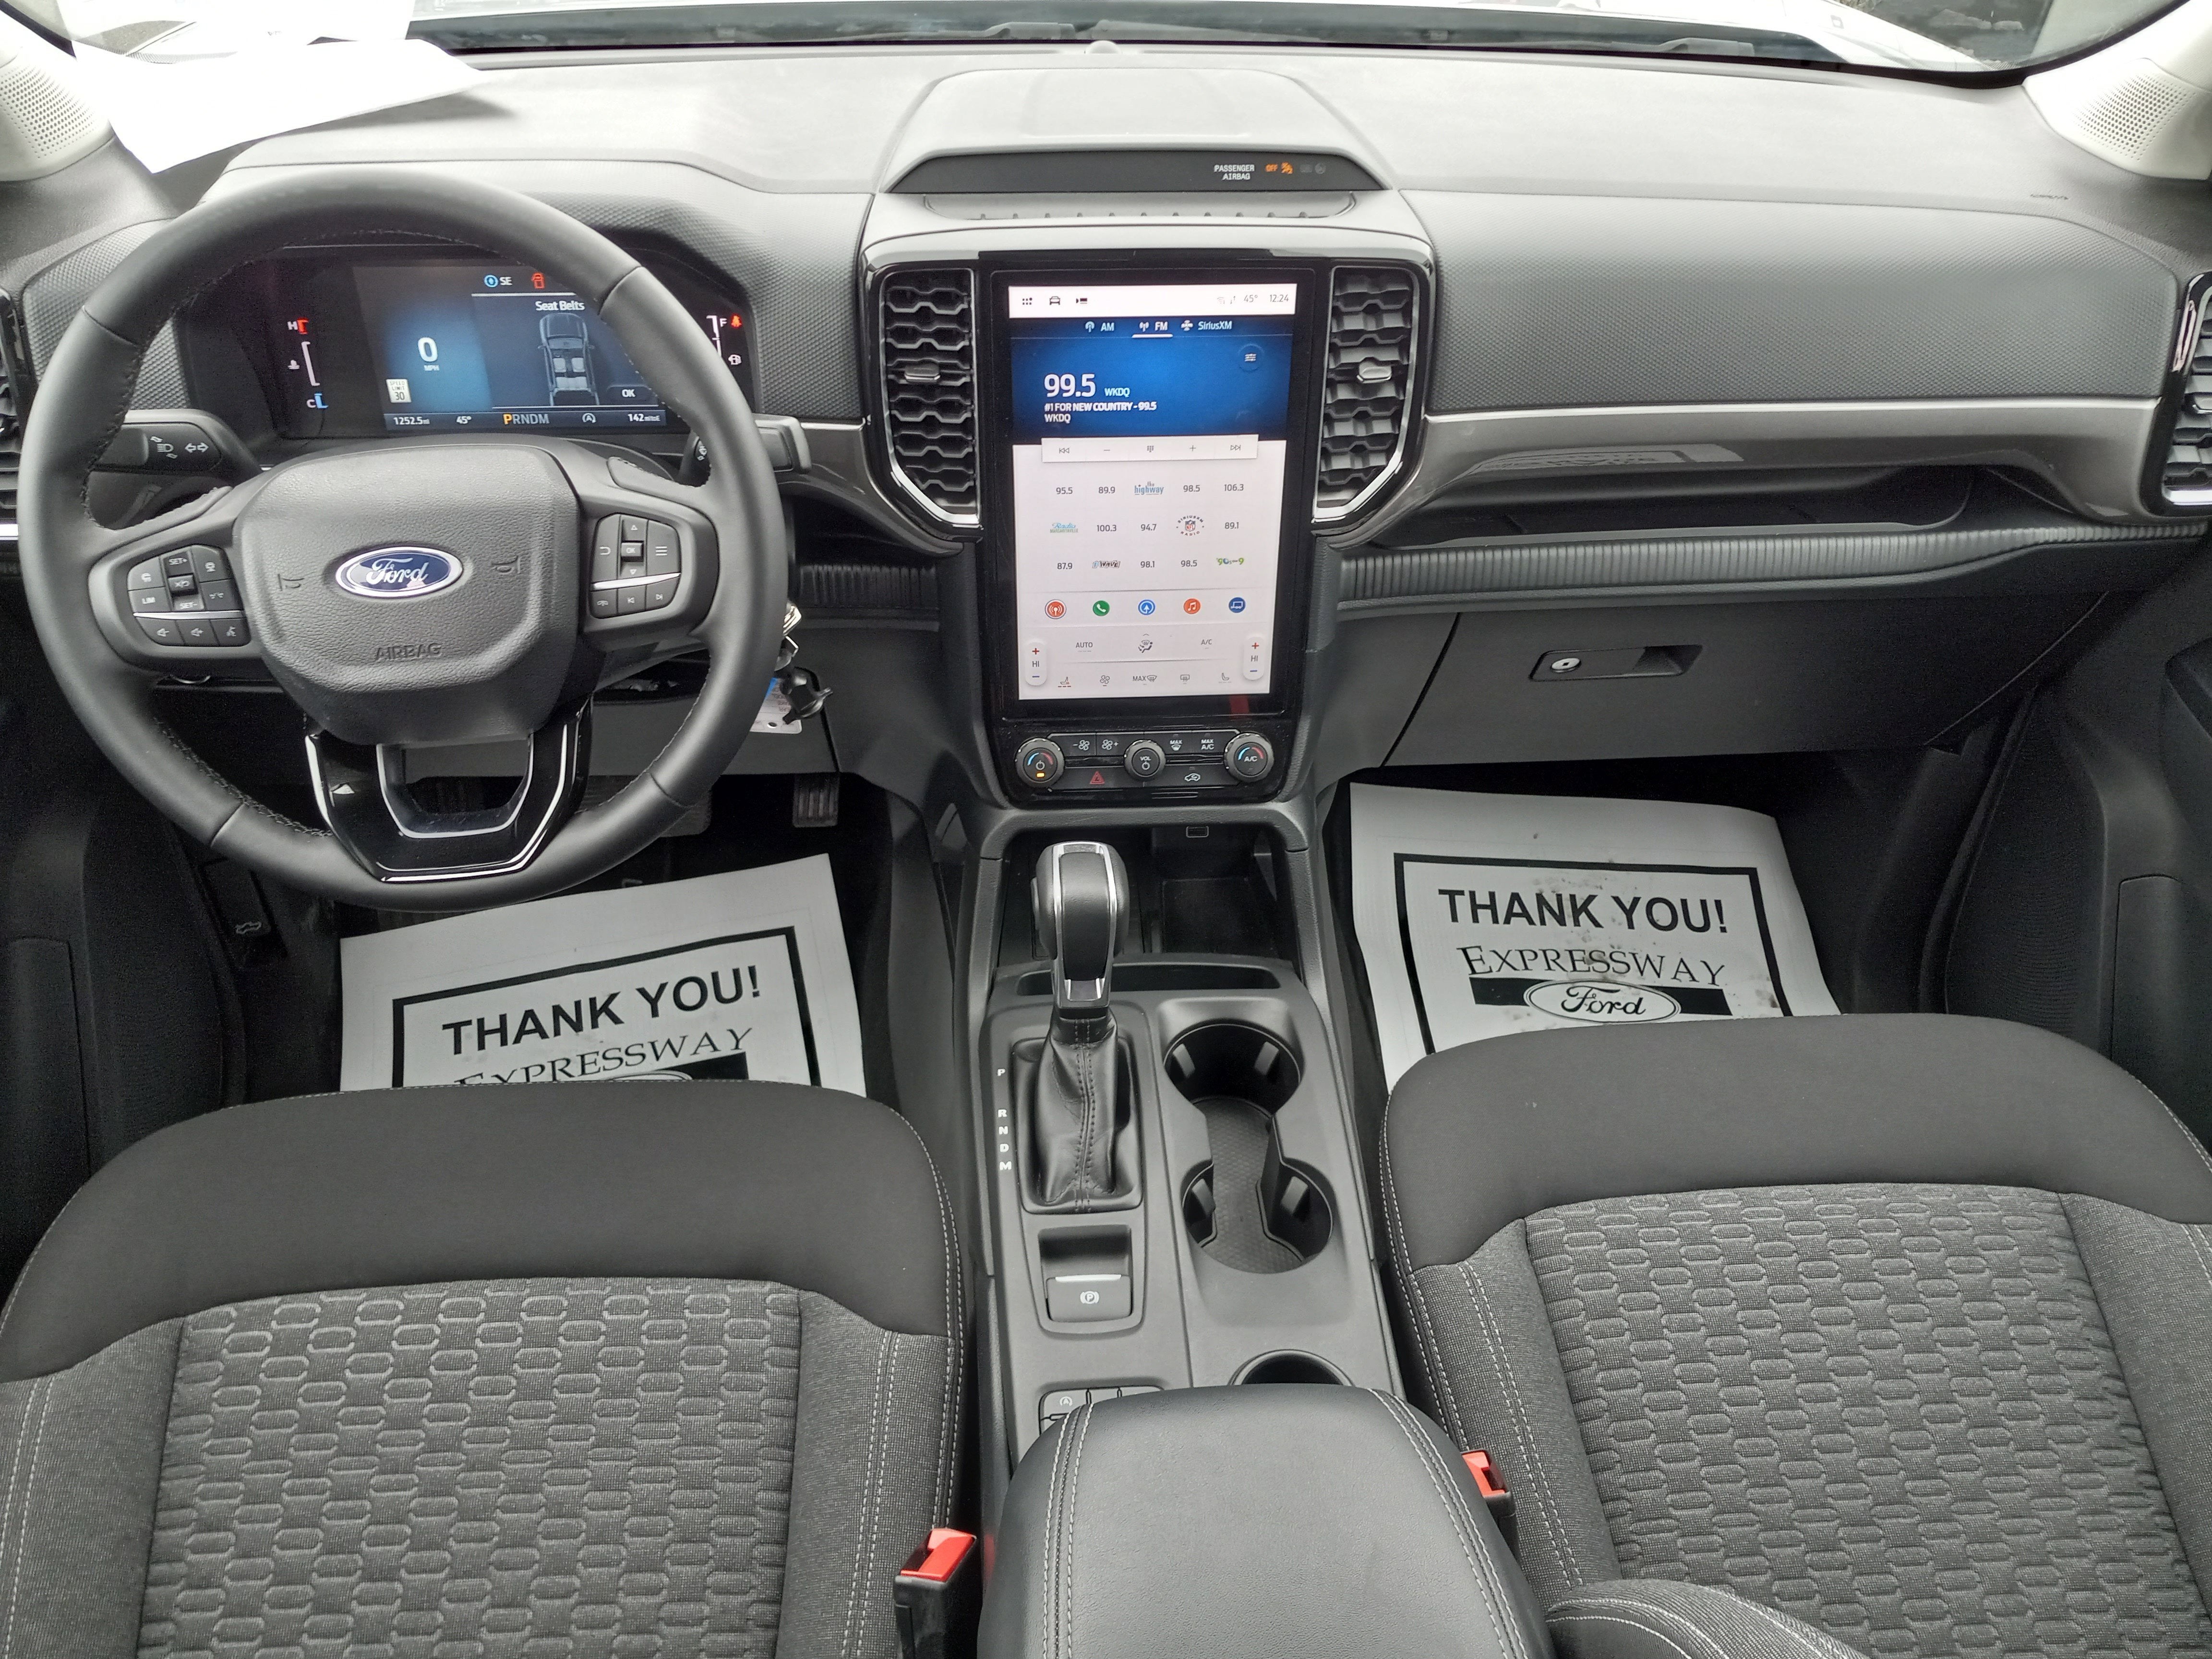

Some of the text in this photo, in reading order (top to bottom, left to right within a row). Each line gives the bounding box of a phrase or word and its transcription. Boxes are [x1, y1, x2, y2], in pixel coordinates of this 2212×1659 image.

[500, 276, 512, 286] SE
[1270, 294, 1289, 302] 12:24
[535, 301, 585, 311] Seat Belts
[1101, 323, 1114, 332] AM
[1154, 322, 1168, 331] FM
[1198, 321, 1232, 330] SiriusXM
[418, 337, 438, 362] 0
[1044, 373, 1096, 397] 99.5
[395, 392, 405, 400] 30
[622, 389, 636, 397] OK
[1105, 387, 1130, 397] WKDQ
[1044, 403, 1054, 411] #1
[1056, 403, 1072, 411] FOR
[1073, 402, 1093, 411] NEW
[1093, 402, 1133, 411] COUNTRY
[1138, 401, 1157, 411] 99.5
[503, 413, 549, 424] PRNDM
[1044, 414, 1071, 424] WKDQ
[1134, 484, 1164, 495] highway
[366, 557, 430, 585] Ford
[376, 642, 444, 661] AIRBAG
[1438, 889, 1728, 933] THANK YOU!
[1456, 946, 1725, 987] EXPRESSWAY
[1561, 985, 1647, 1015] Ford
[442, 965, 761, 1056] THANK YOU!
[998, 1109, 1007, 1118] R
[998, 1126, 1009, 1135] N
[999, 1143, 1009, 1152] D
[999, 1161, 1012, 1171] M
